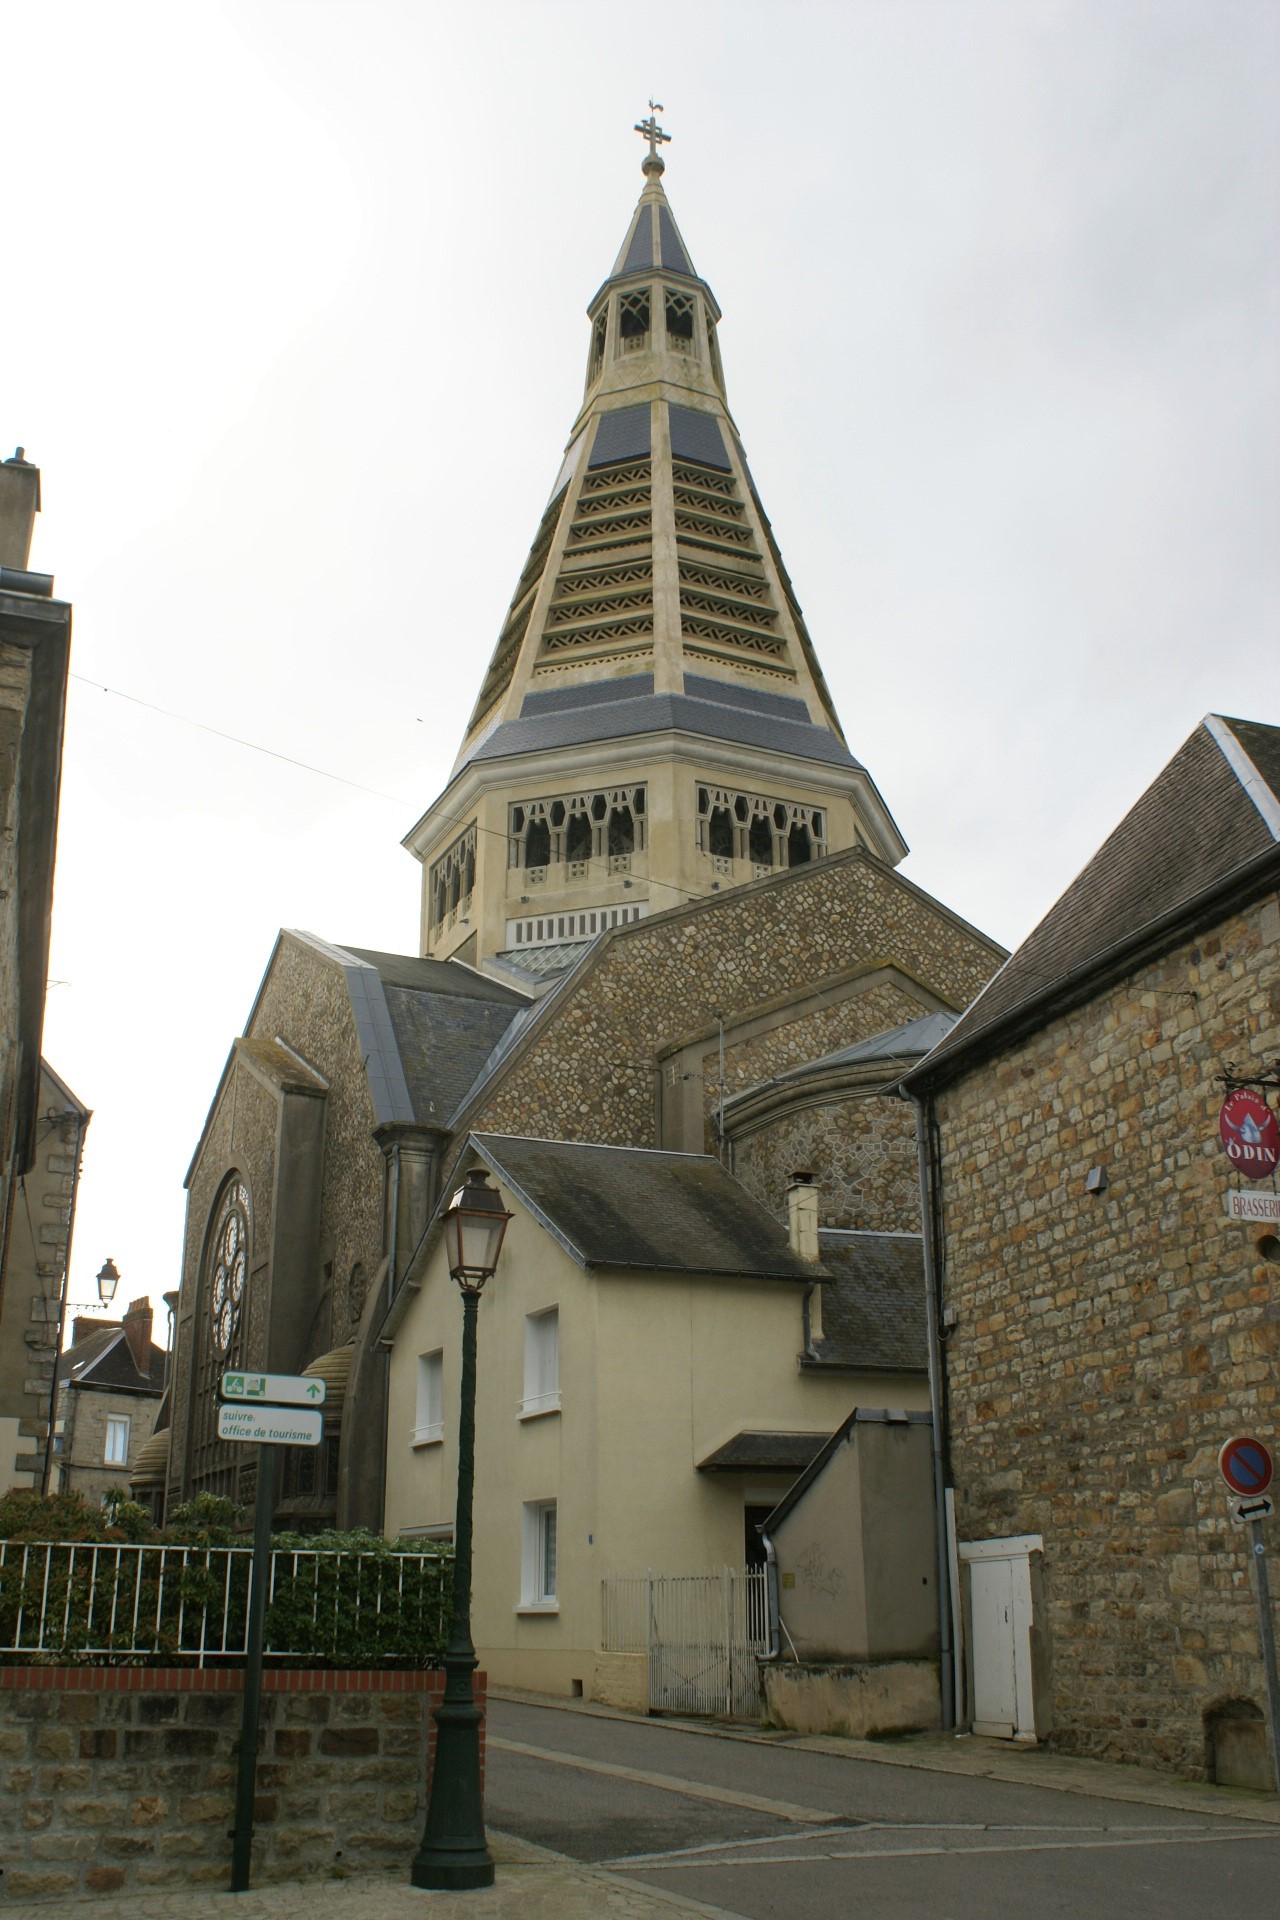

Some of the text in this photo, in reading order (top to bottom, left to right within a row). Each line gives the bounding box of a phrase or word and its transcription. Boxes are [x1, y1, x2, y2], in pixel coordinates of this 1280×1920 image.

[222, 1425, 312, 1440] office de tourisme
